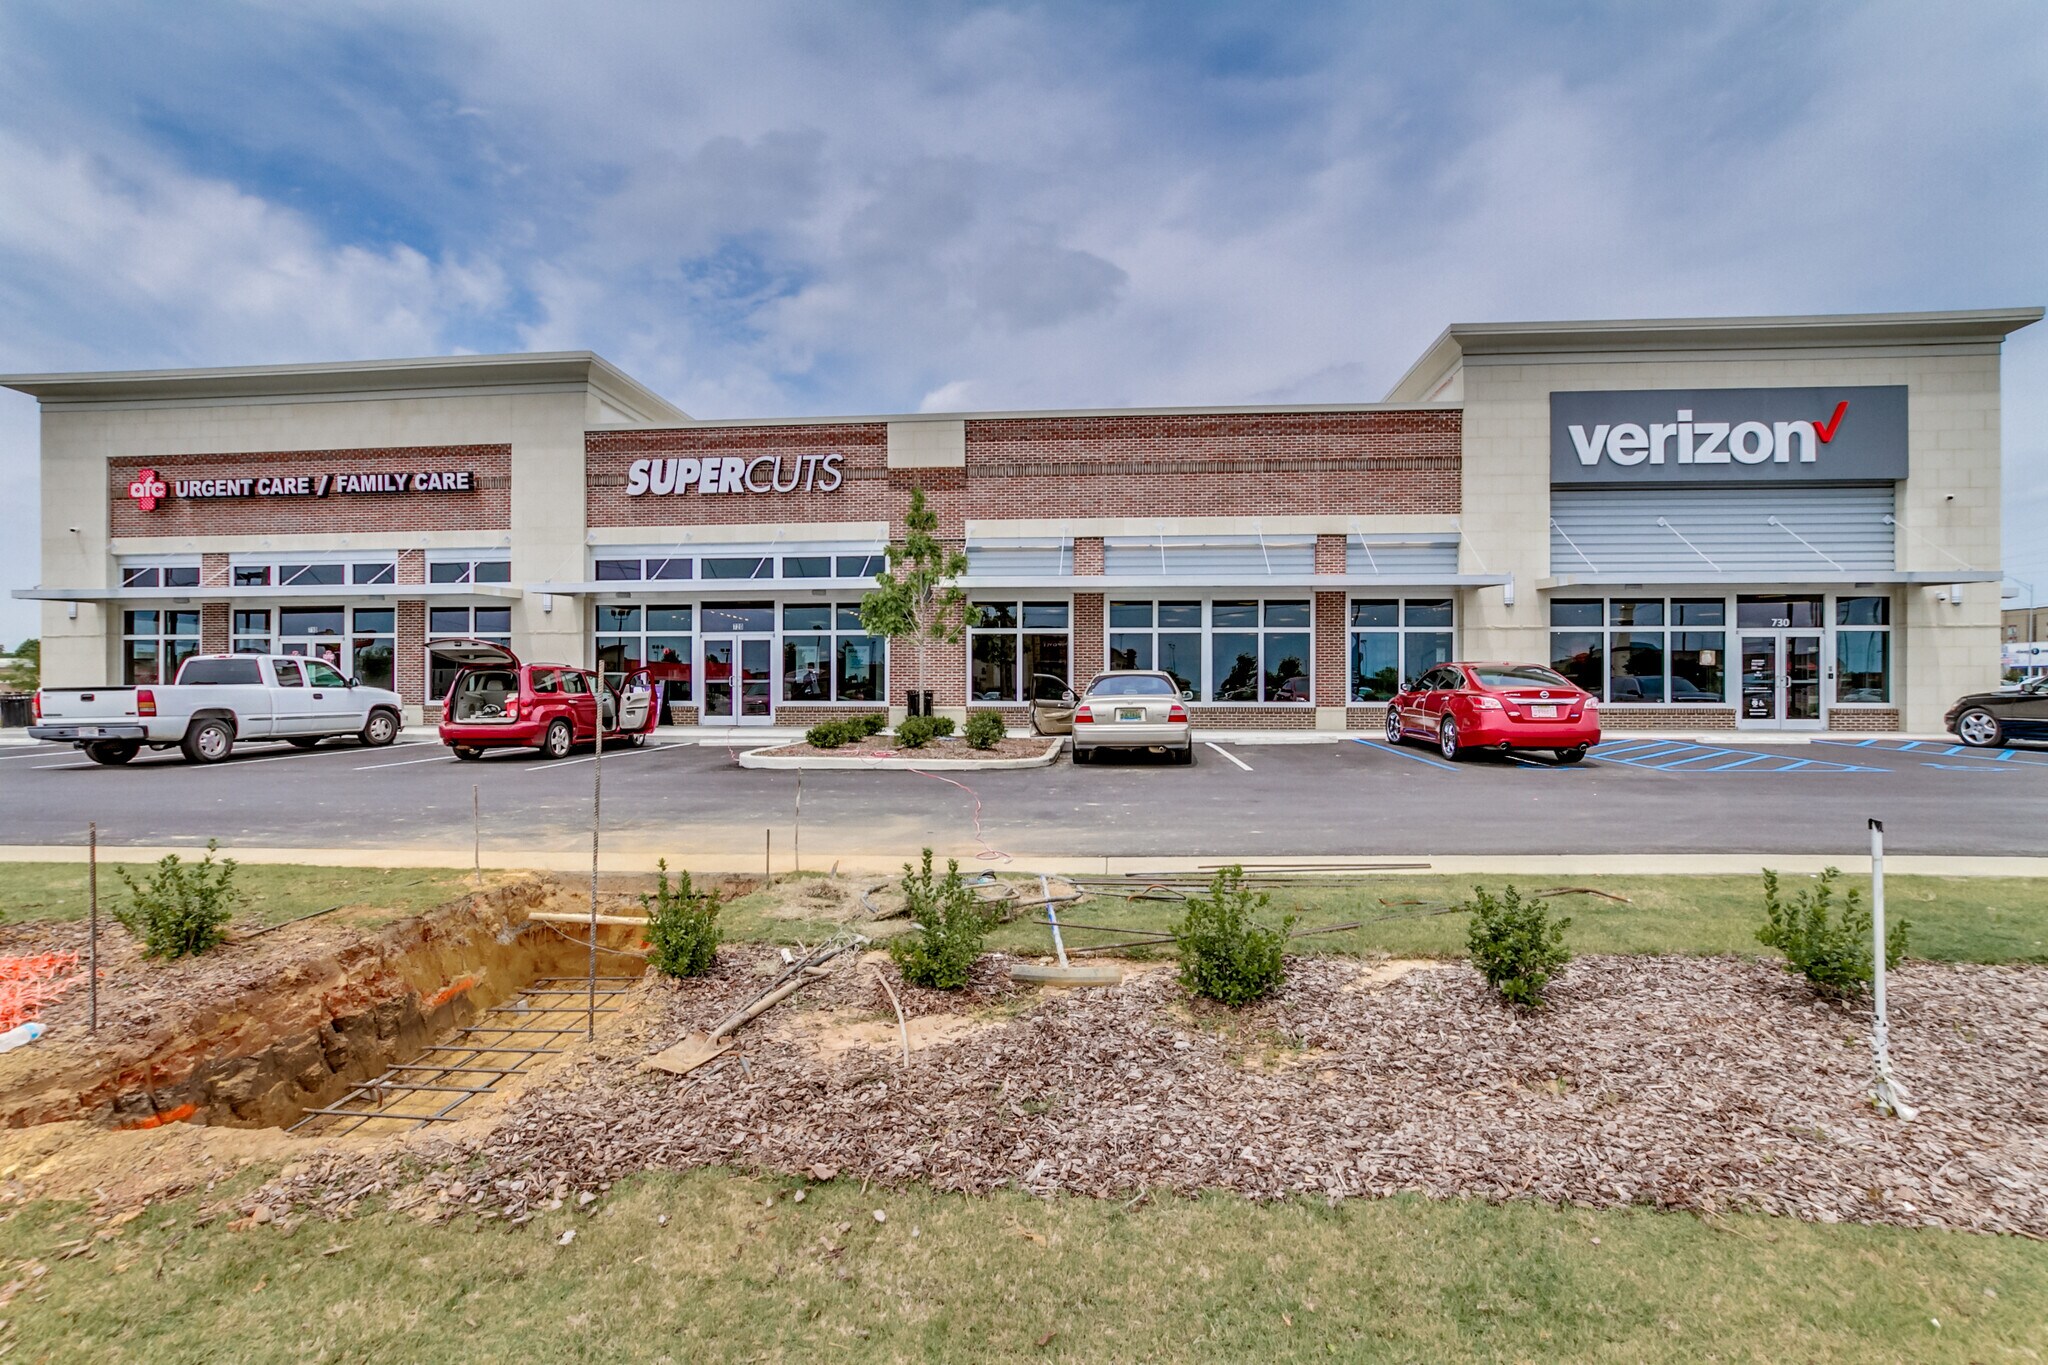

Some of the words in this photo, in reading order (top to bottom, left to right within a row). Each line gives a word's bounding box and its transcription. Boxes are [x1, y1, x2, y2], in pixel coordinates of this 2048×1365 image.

[1568, 409, 1817, 466] verizon
[130, 476, 167, 498] afc
[175, 479, 253, 498] URGENT
[257, 477, 310, 496] CARE
[317, 475, 328, 496] /
[337, 474, 408, 493] FAMILY
[414, 472, 469, 491] CARE
[626, 453, 845, 496] SUPERCUTS
[1771, 618, 1790, 627] 730
